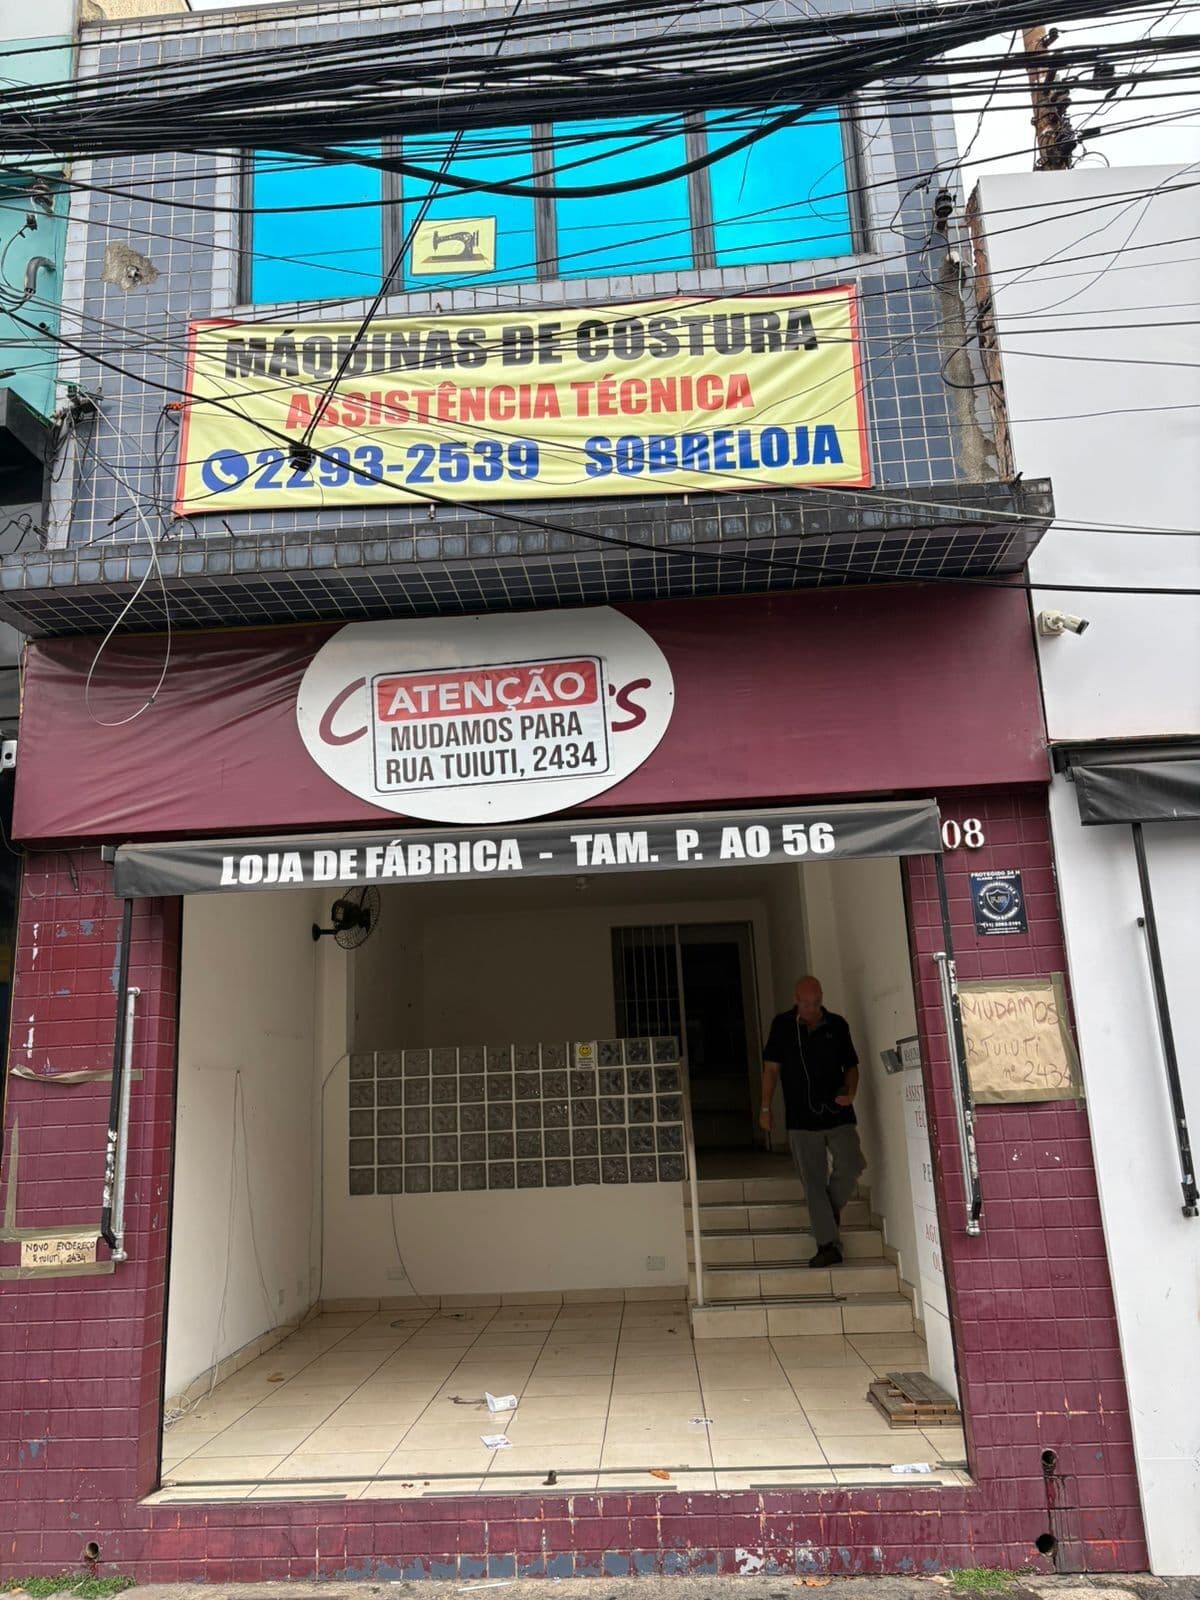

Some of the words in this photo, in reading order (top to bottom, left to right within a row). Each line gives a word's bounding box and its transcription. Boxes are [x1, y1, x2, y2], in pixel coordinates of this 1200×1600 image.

[226, 327, 486, 379] MÁQUINAS
[502, 320, 562, 364] DE
[577, 309, 818, 361] COSTURA
[285, 382, 558, 430] ASSISTÊNCIA
[570, 373, 753, 414] TÉCNICA
[254, 440, 540, 489] 2293-2539
[585, 425, 844, 477] SOBRELOJA
[387, 668, 585, 712] ATENÇÃO
[391, 717, 513, 752] MUDAMOS
[520, 711, 582, 739] PARA
[386, 756, 434, 784] RUA
[441, 748, 525, 778] TUIUTI,
[533, 741, 597, 772] 2434
[219, 851, 304, 886] LOJA
[312, 849, 358, 881] DE
[365, 839, 523, 878] FÁBRICA
[570, 831, 659, 867] TAM.
[676, 829, 702, 861] P.
[719, 826, 770, 859] AO
[782, 822, 835, 855] 56
[960, 996, 1059, 1026] MUDAMOS
[26, 1243, 49, 1253] NOVO
